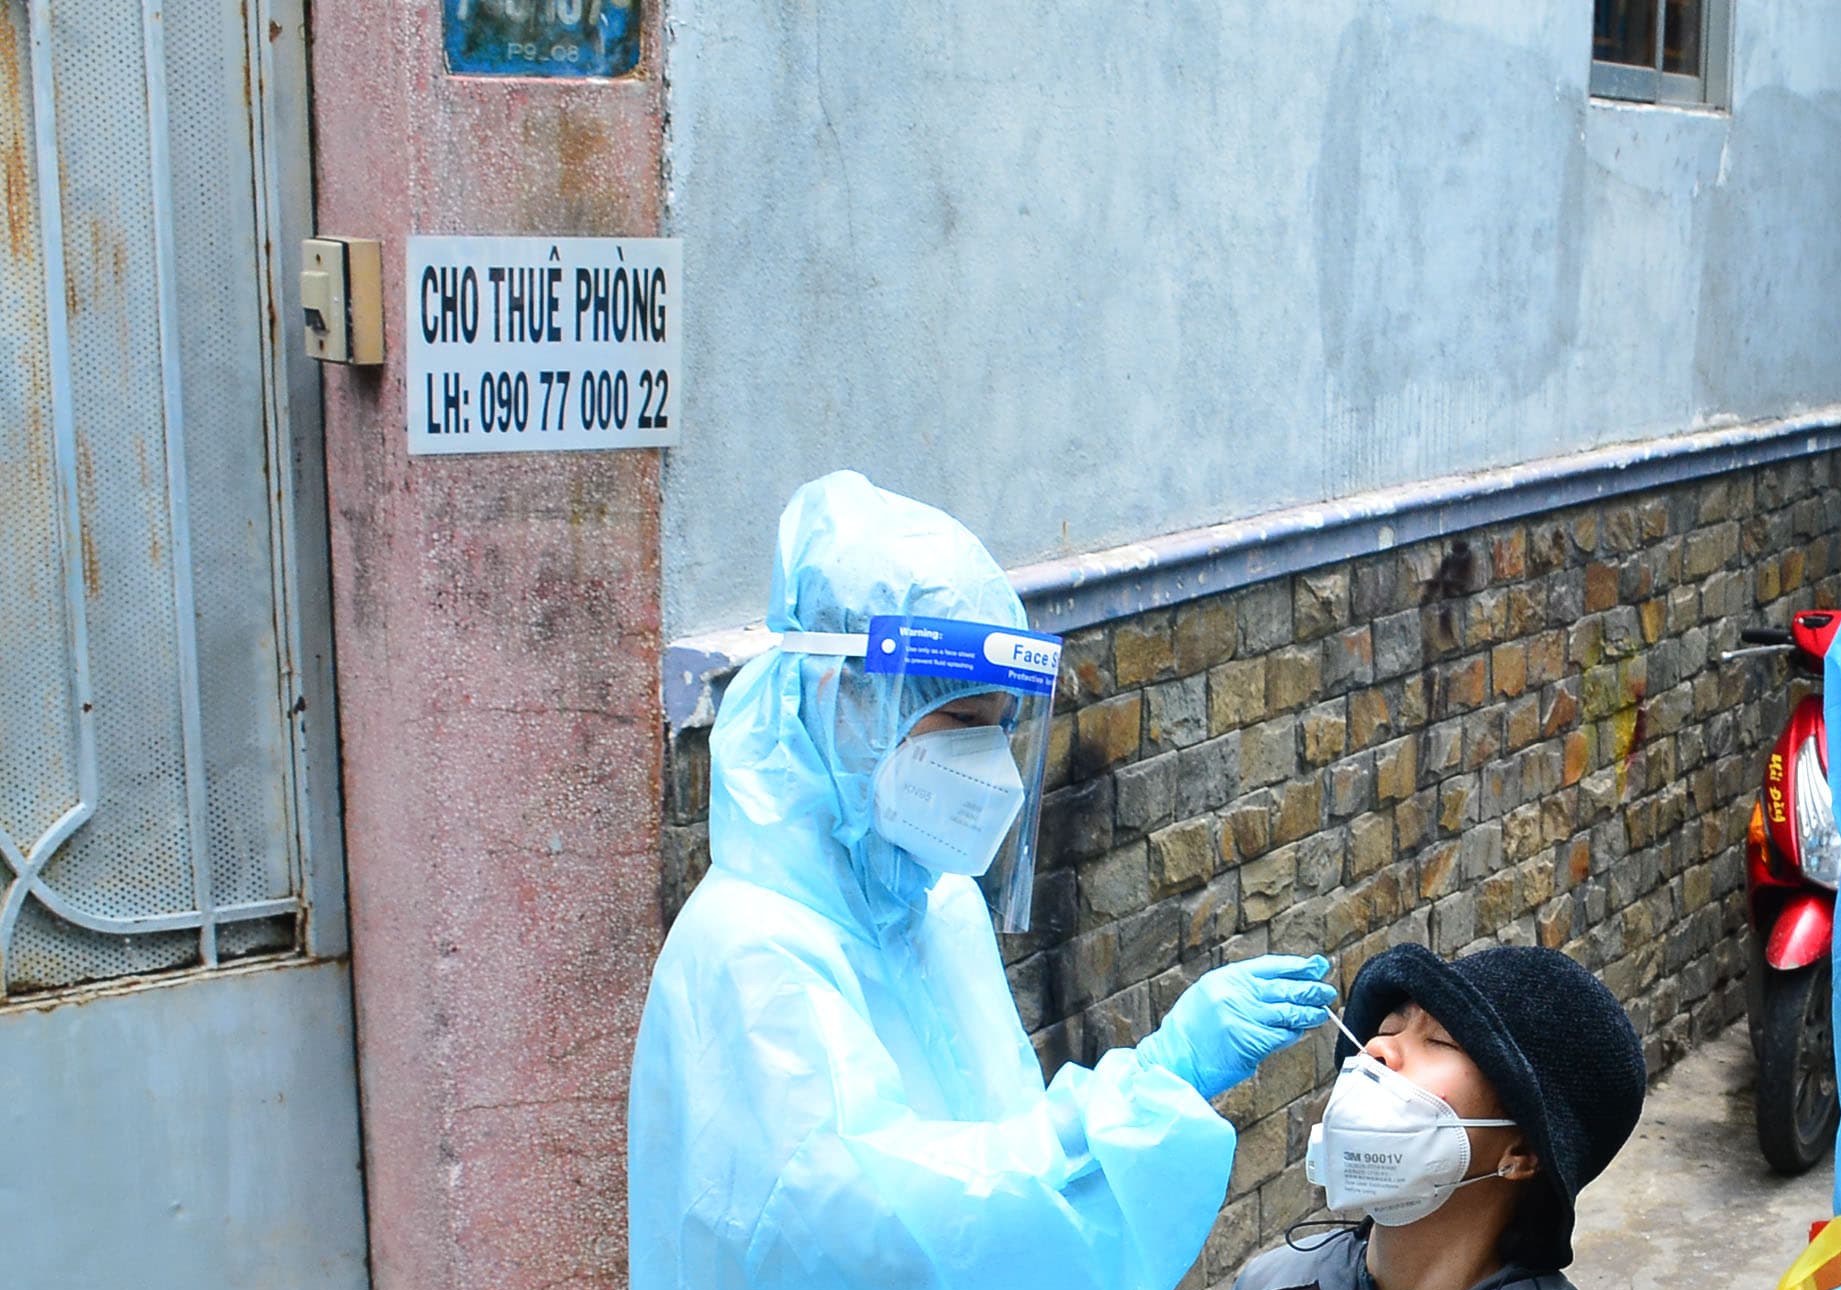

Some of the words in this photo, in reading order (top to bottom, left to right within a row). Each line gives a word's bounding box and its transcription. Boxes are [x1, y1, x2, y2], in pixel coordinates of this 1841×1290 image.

[421, 264, 479, 344] CHO
[488, 244, 562, 344] THUÊ
[575, 245, 666, 344] PHÒNG
[427, 371, 469, 434] LH:
[479, 371, 529, 433] 090
[540, 371, 570, 431] 77
[580, 369, 629, 430] 000
[638, 369, 669, 429] 22
[900, 626, 944, 641] Warning:
[1012, 643, 1049, 667] Face
[1343, 1151, 1361, 1162] 3M
[1363, 1152, 1403, 1164] 9001V
